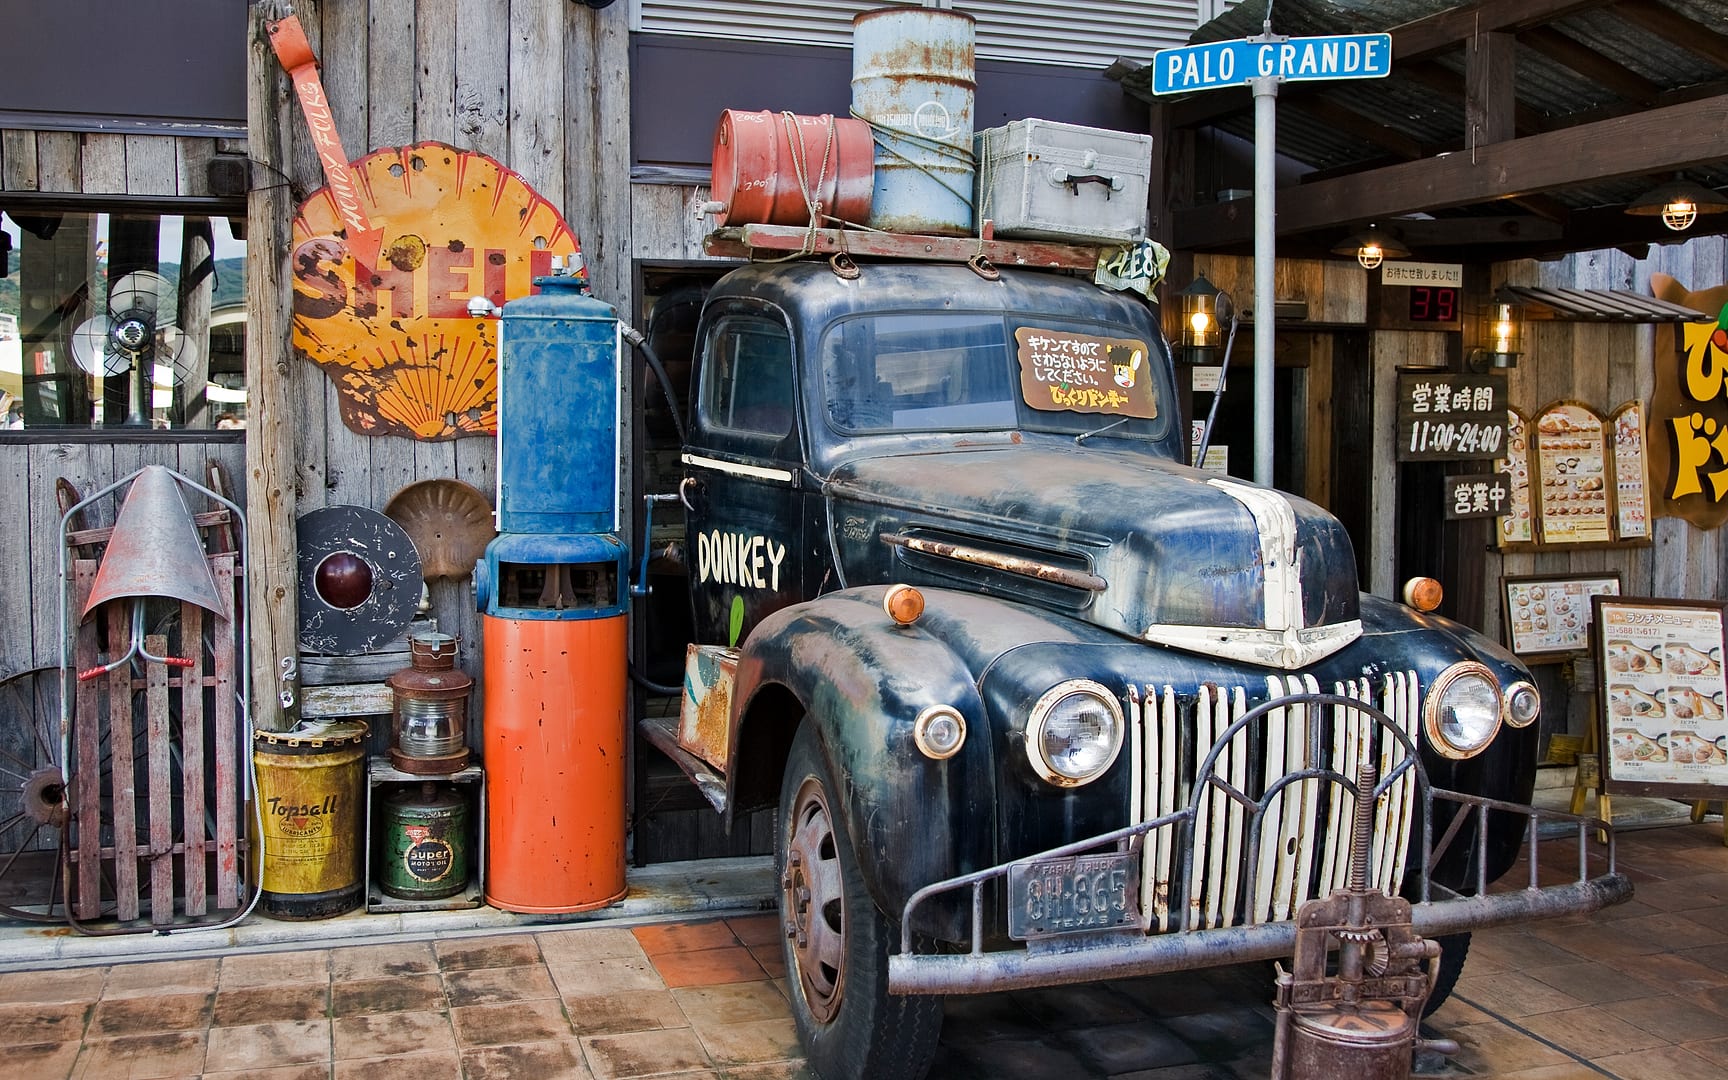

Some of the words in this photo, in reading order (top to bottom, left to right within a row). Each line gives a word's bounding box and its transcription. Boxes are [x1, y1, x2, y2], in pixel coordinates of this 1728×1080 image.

[1168, 47, 1235, 87] PALO
[1257, 40, 1380, 77] GRANDE
[301, 82, 336, 147] FOLKS
[1413, 288, 1454, 320] 39
[1028, 335, 1100, 355] キケンですので
[1031, 352, 1107, 372] さわらないように
[1034, 367, 1099, 386] してください。
[1412, 382, 1493, 414] 営業時間
[1454, 481, 1505, 514] 営業中
[699, 529, 785, 592] DONKEY
[1627, 613, 1691, 625] ランチメニュー
[267, 794, 338, 821] Topsall
[282, 825, 321, 836] LUBRICANTS
[1043, 863, 1072, 875] FARM
[1078, 860, 1115, 872] TRUCK
[1052, 915, 1108, 929] TEXAS
